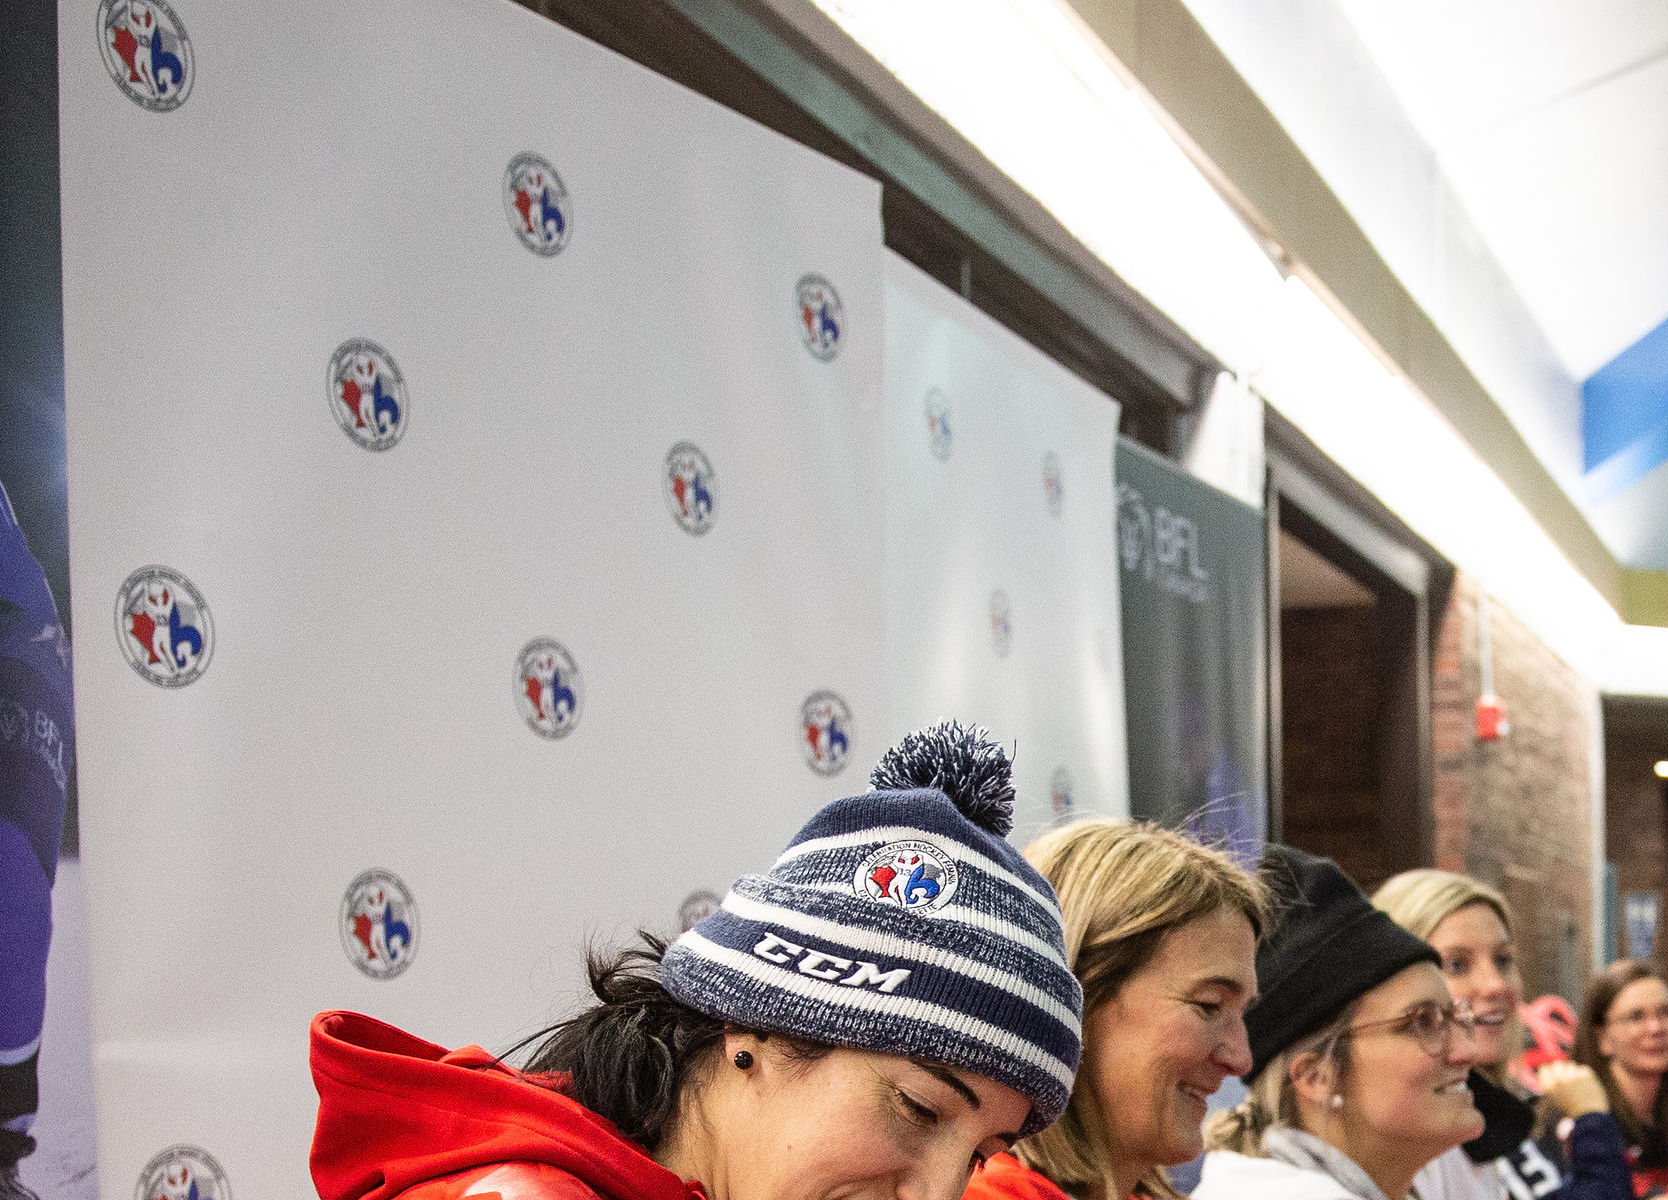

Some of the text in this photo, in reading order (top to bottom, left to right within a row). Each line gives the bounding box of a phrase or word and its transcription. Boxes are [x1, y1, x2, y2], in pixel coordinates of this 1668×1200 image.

[1156, 506, 1208, 579] BFL
[913, 842, 948, 863] HOCKEY
[753, 931, 912, 993] CCM
